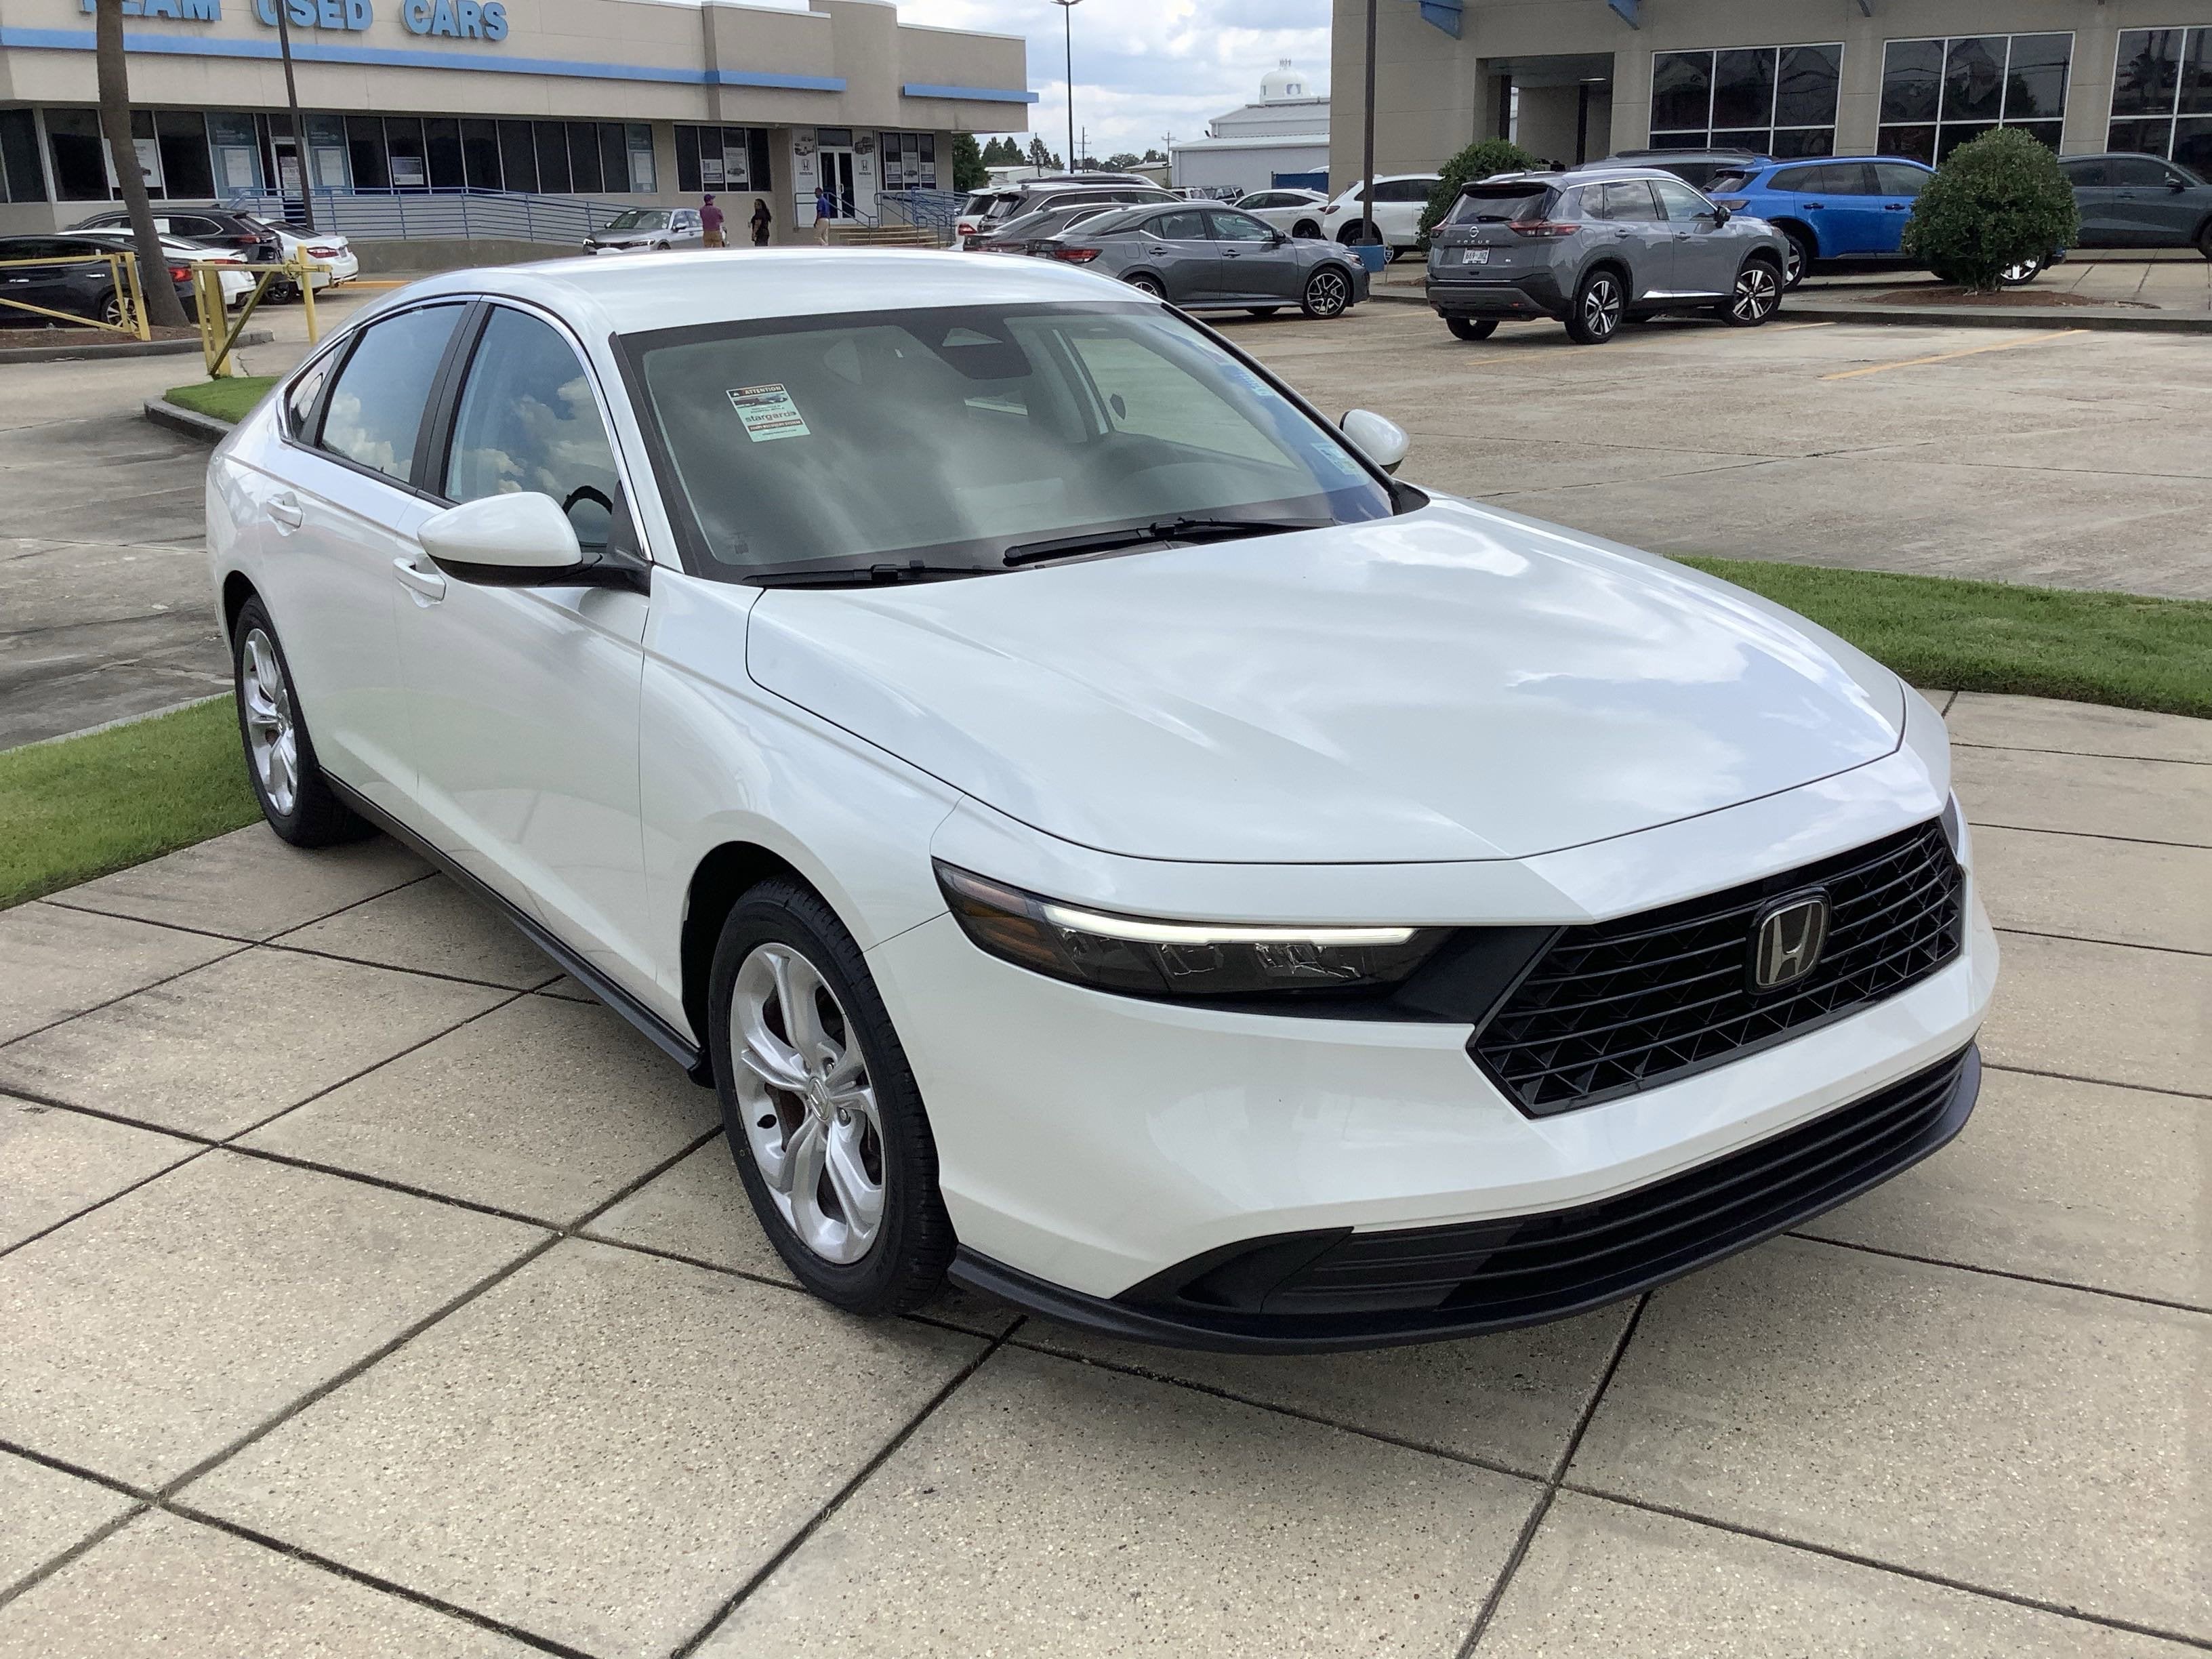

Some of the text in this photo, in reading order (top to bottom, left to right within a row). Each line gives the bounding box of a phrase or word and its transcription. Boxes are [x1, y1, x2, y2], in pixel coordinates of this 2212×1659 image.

[81, 0, 508, 41] AM USED CARS
[745, 386, 781, 394] ATTENTION
